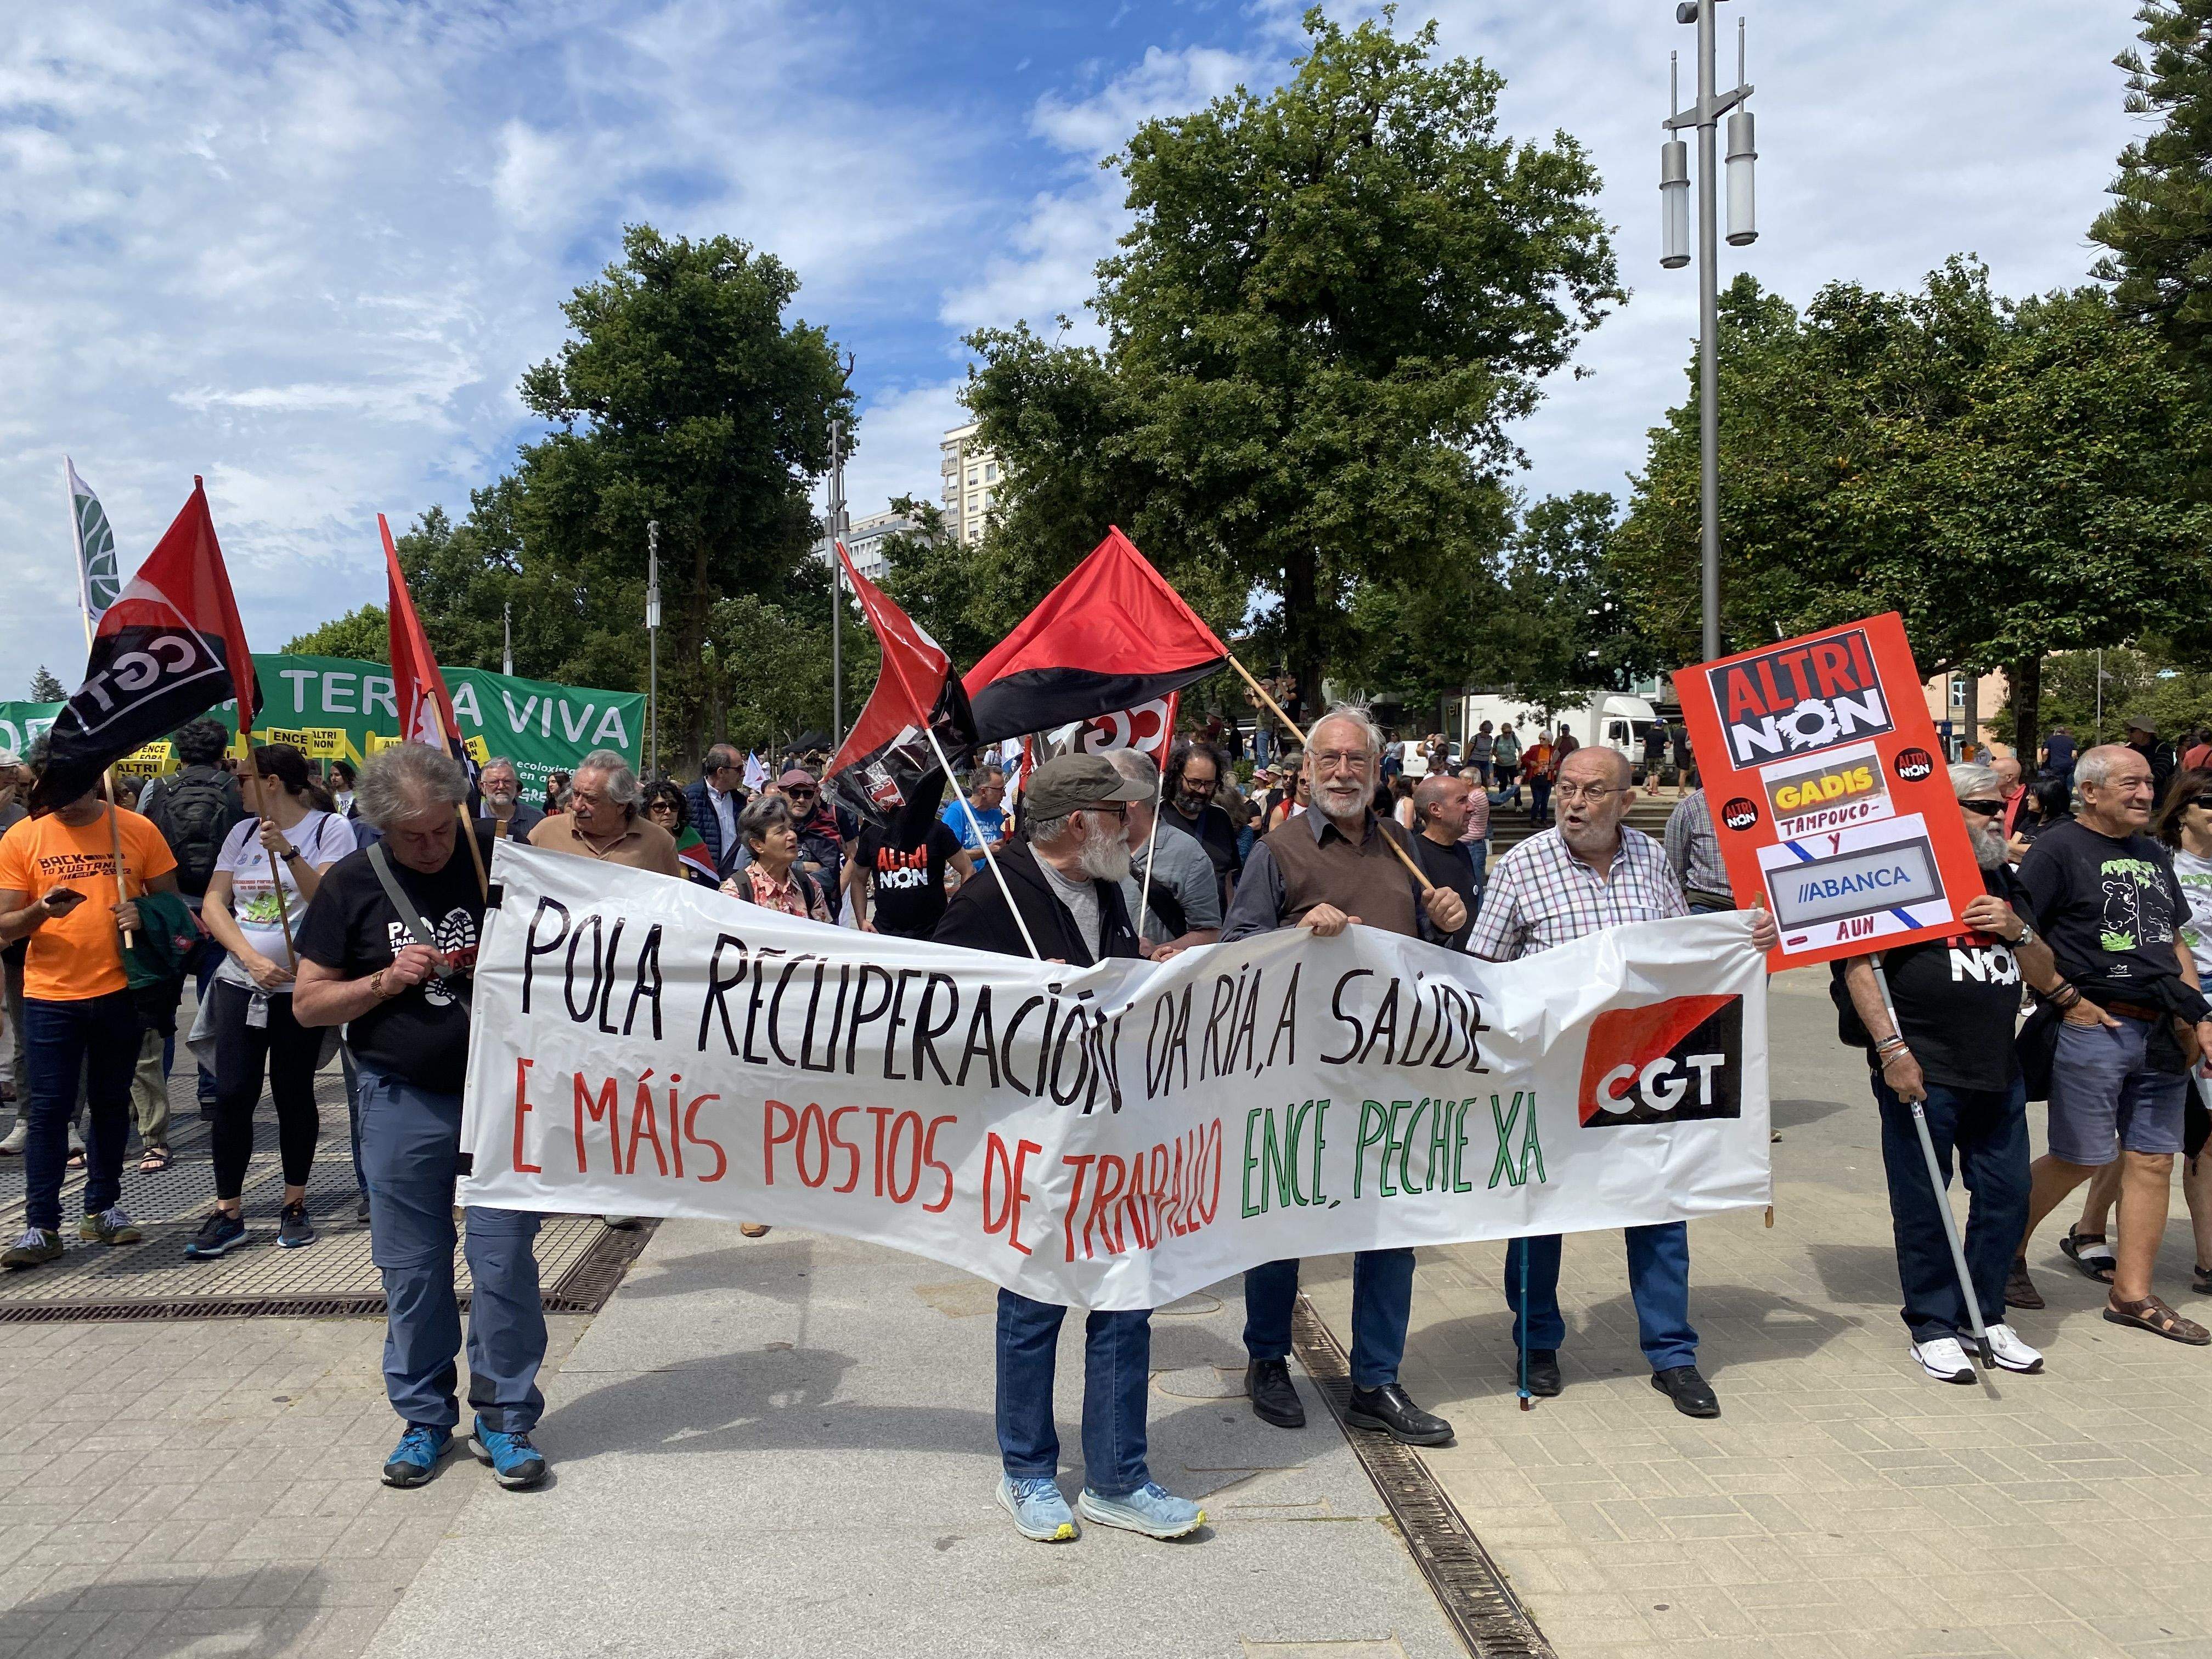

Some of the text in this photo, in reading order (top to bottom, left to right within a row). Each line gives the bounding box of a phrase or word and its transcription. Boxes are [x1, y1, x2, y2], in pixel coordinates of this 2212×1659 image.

[1728, 635, 1875, 723] ALTRI
[280, 670, 483, 727] TERA
[503, 690, 629, 748] VIVA
[1731, 688, 1887, 761] NON
[273, 731, 308, 744] ENCE
[142, 745, 166, 753] ENCE
[117, 764, 157, 773] ALTRI
[1899, 752, 1928, 769] ALTRI
[520, 772, 535, 781] en
[1899, 764, 1930, 778] NON
[1775, 766, 1874, 811] GADIS
[1726, 801, 1752, 819] ALTRI
[1727, 812, 1756, 827] NON
[1827, 832, 1841, 855] Y
[37, 854, 86, 868] BACK
[42, 868, 55, 876] TO
[879, 867, 928, 889] NON
[1836, 916, 1875, 941] AUN
[522, 895, 662, 1040] POLA
[1147, 982, 1193, 1101] DA
[1266, 962, 1302, 1066] A
[1321, 969, 1491, 1075] SAÚDE
[1596, 1053, 1725, 1114] CGT
[513, 1057, 541, 1173] E
[765, 1099, 958, 1213] POSTOS
[983, 1132, 1042, 1255] DE
[1062, 1116, 1222, 1262] TRABALLO
[1242, 1099, 1341, 1219] ENCE,
[1353, 1095, 1477, 1199] PECHE
[1488, 1091, 1546, 1189] XA
